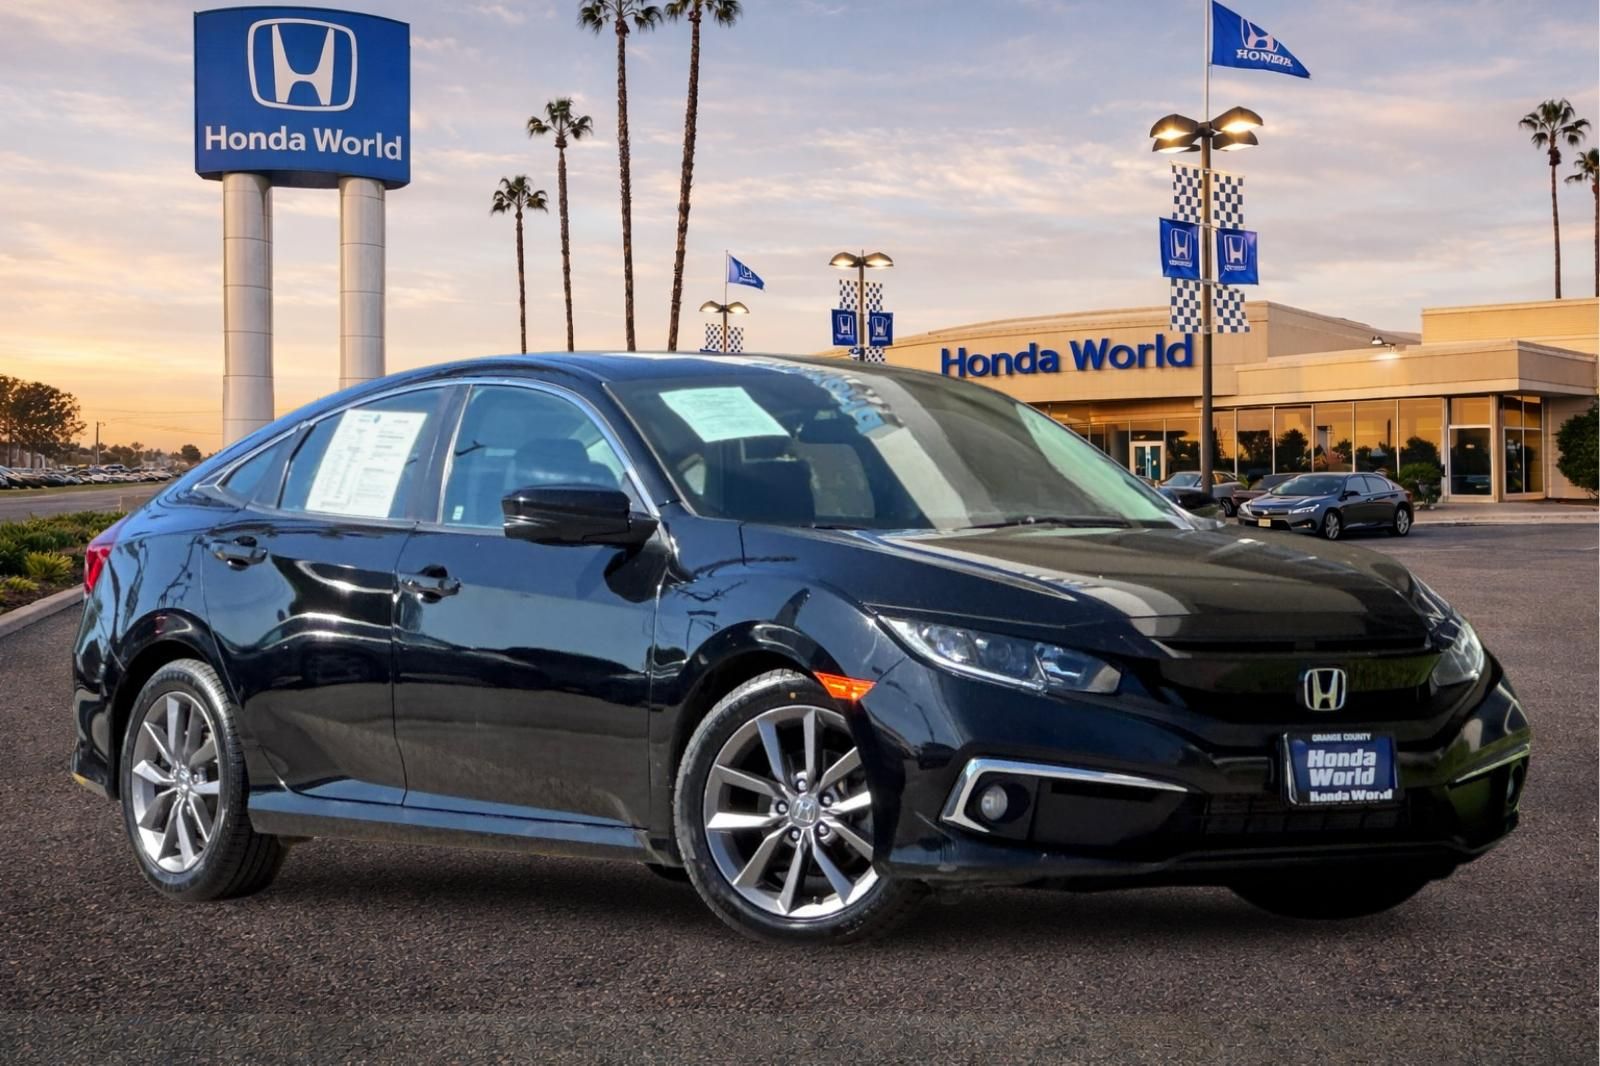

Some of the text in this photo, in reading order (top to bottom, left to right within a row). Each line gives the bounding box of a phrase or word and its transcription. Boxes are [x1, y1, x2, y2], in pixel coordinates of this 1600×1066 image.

[205, 125, 402, 160] Honda World
[941, 333, 1194, 378] Honda World
[1311, 733, 1371, 742] ORANGE COUNTY
[1307, 748, 1376, 768] Honda
[1309, 767, 1375, 787] World
